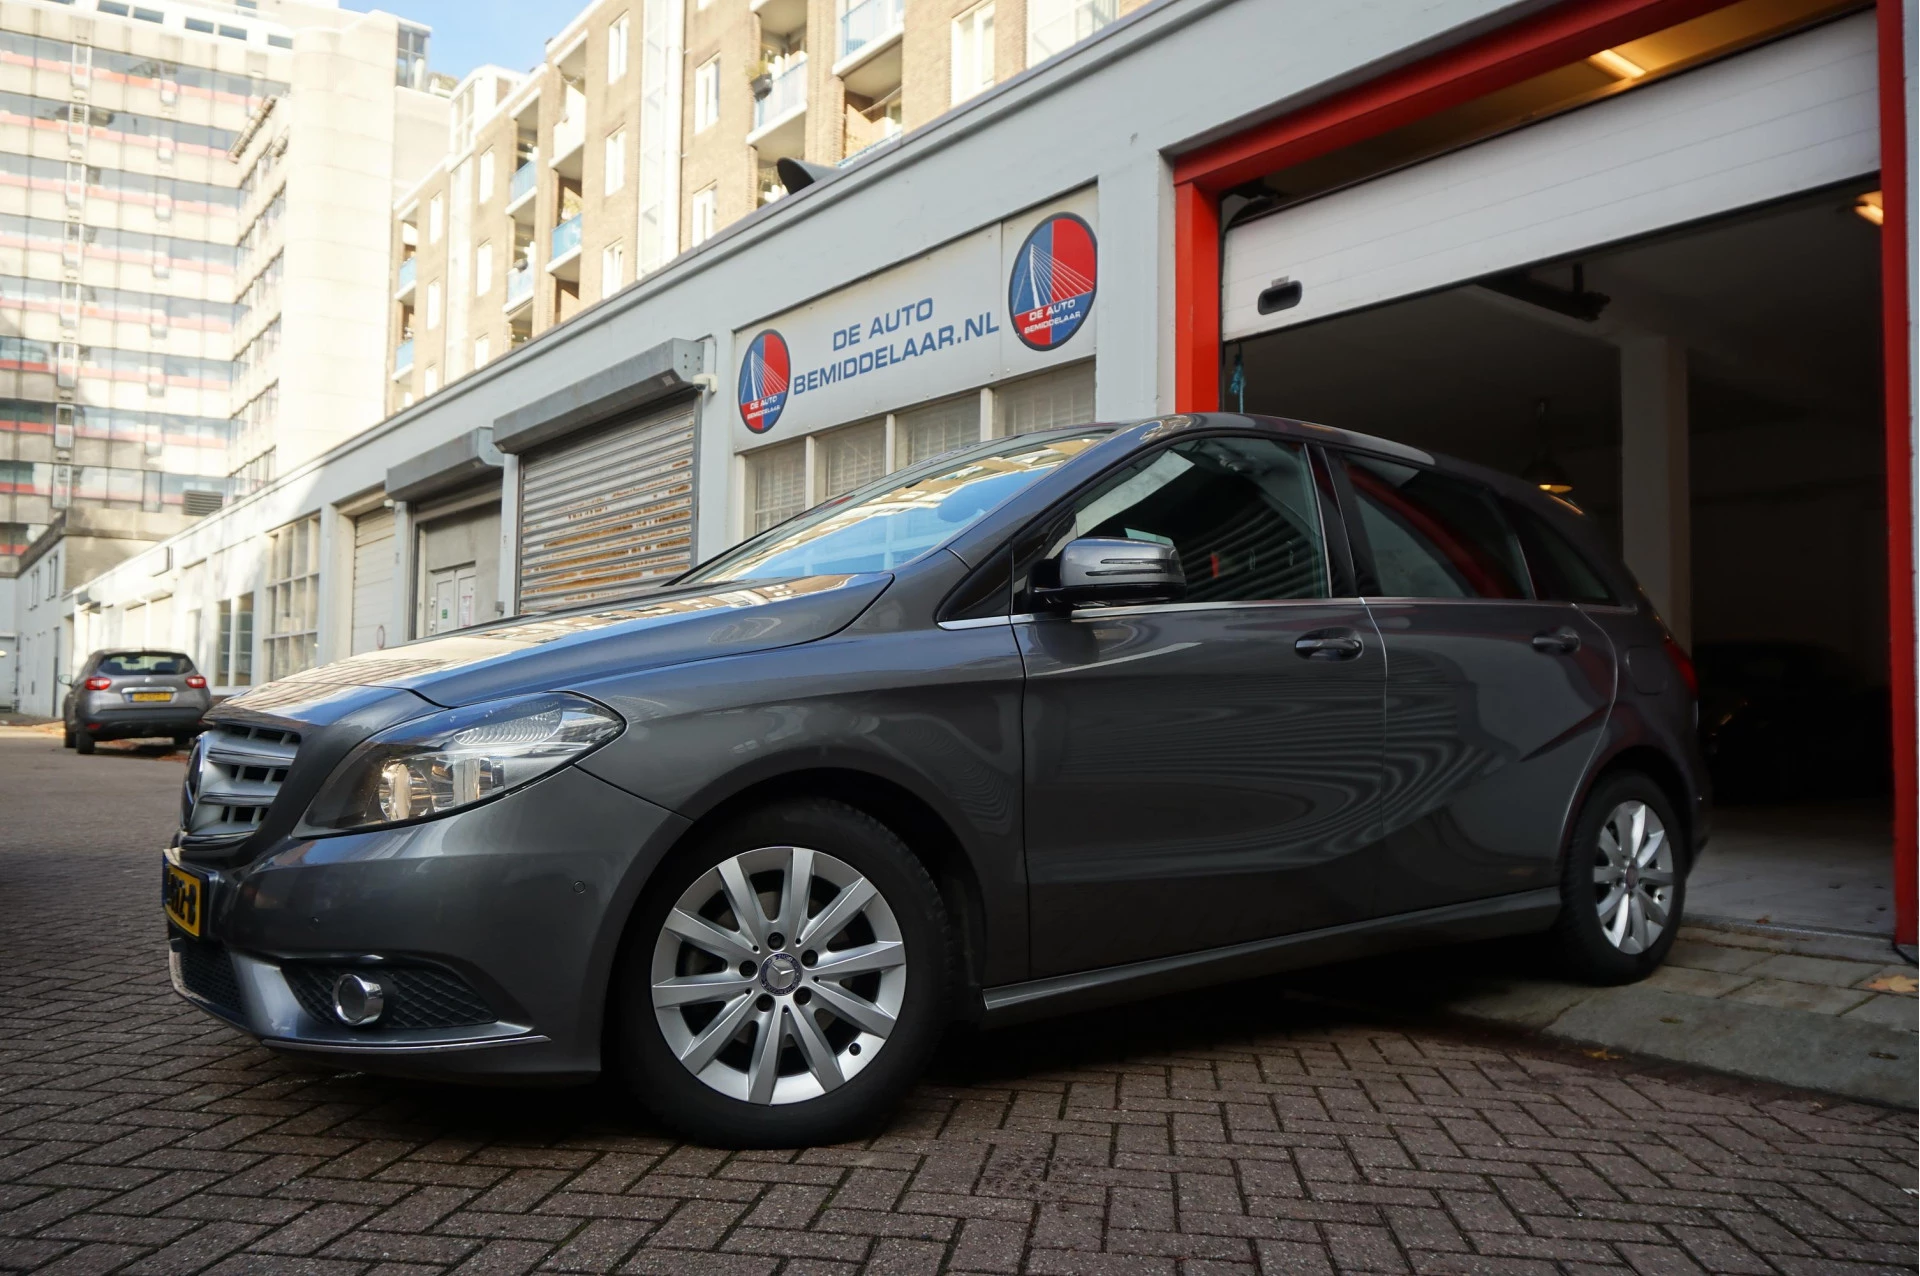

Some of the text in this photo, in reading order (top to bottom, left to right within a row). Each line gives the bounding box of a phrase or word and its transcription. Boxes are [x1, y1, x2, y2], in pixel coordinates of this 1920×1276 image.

[833, 297, 933, 351] DE AUTO
[1024, 311, 1081, 334] BEMIDDELAAR
[1029, 299, 1075, 321] DE AUTO
[793, 312, 999, 395] BEMIDDELAAR.NL
